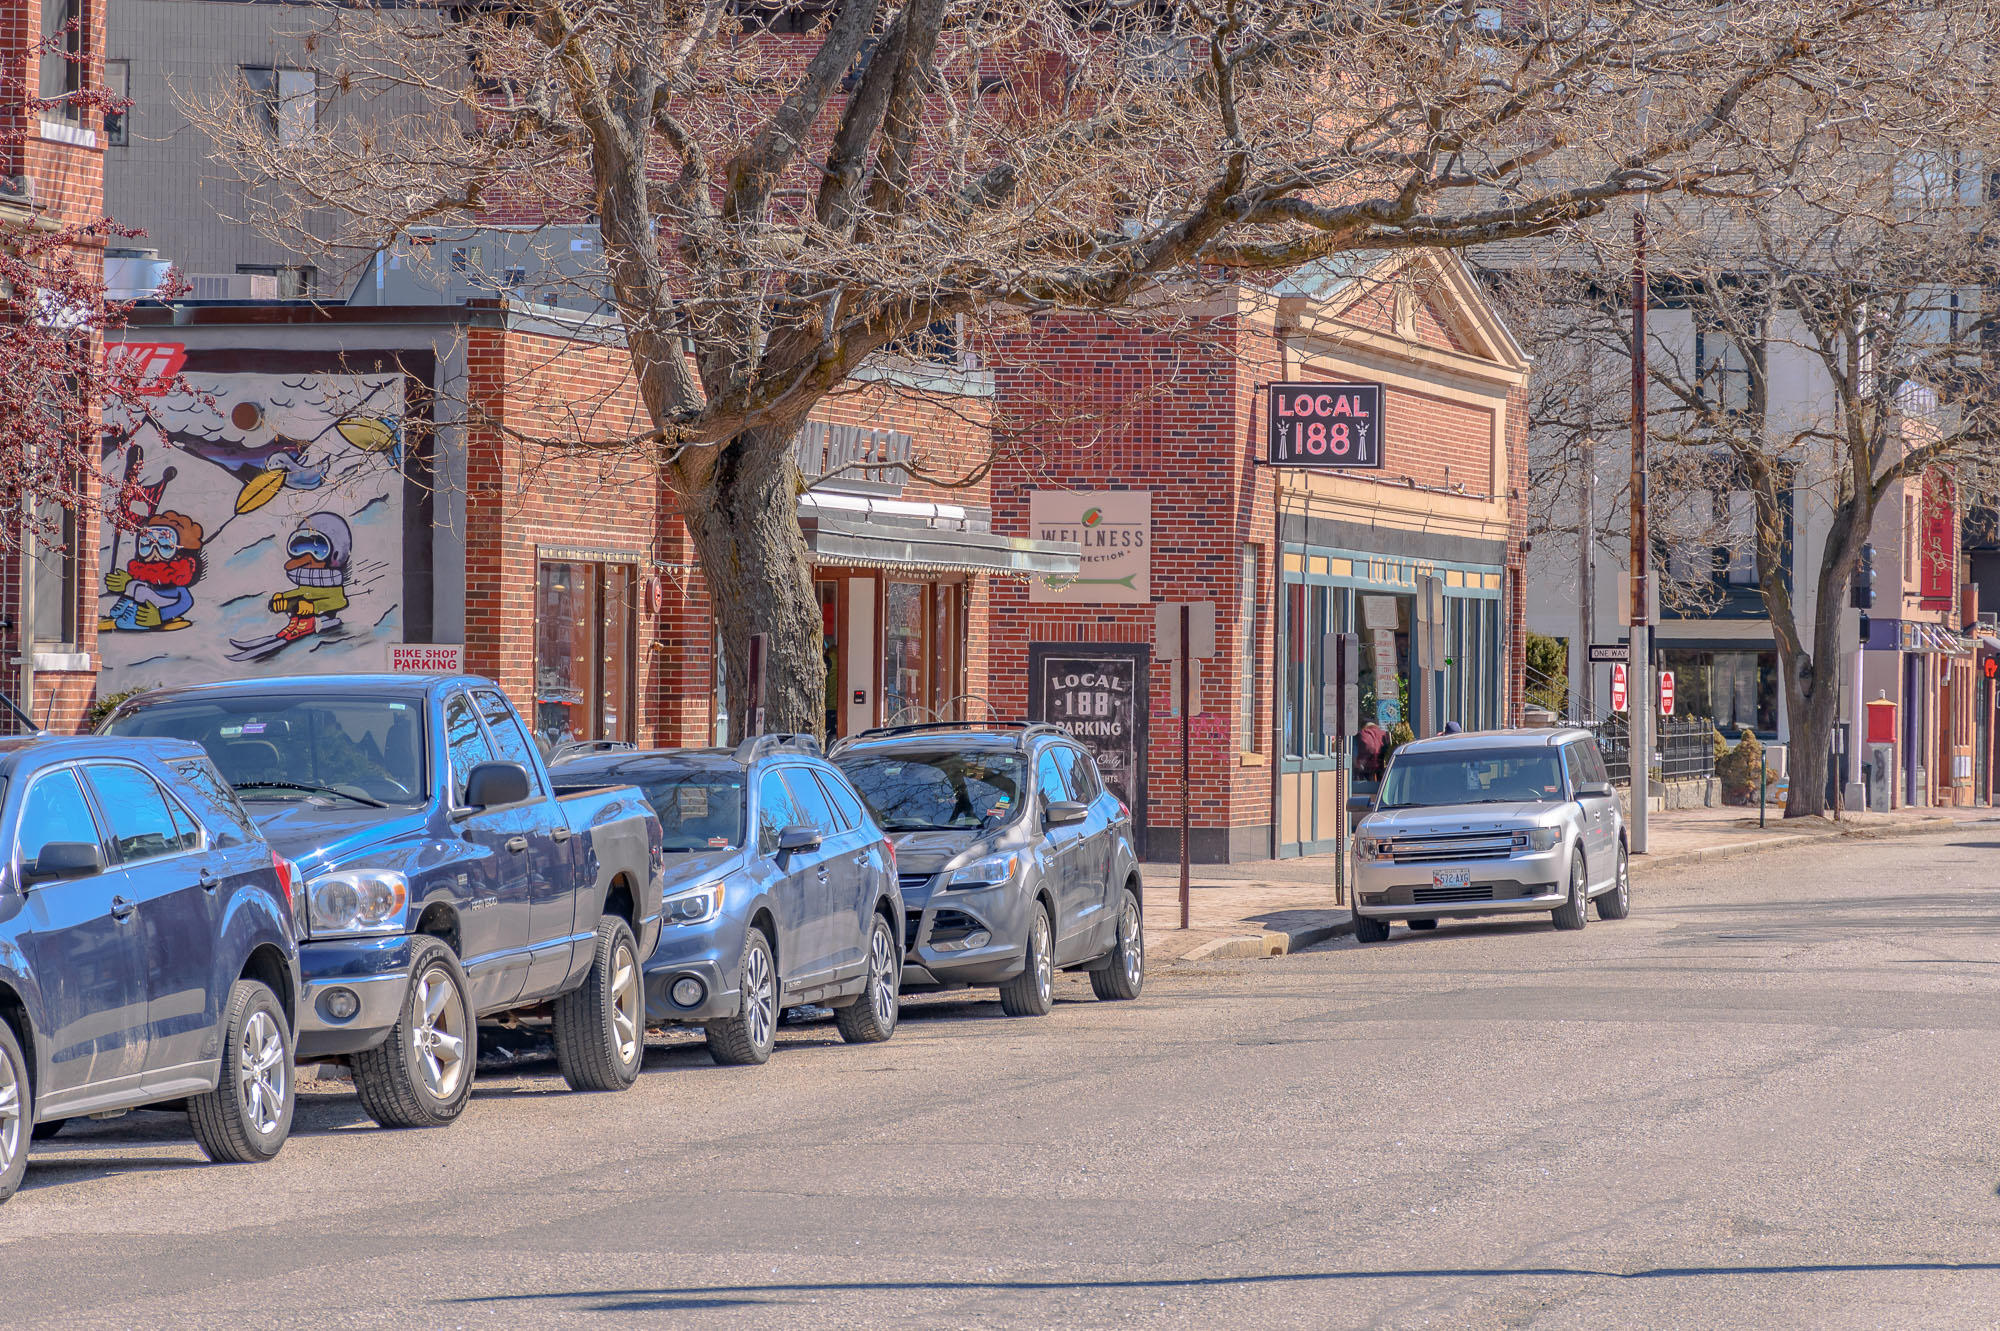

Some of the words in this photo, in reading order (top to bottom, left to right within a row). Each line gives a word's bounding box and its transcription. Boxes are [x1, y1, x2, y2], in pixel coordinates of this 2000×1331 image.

[1278, 393, 1370, 417] LOCAL
[1295, 421, 1350, 456] 188
[1041, 529, 1144, 548] WELLNESS
[1080, 550, 1125, 563] NECTION
[1368, 555, 1409, 588] LOCAL
[394, 649, 421, 658] BIKE
[425, 649, 457, 658] SHOP
[1593, 649, 1609, 658] ONE
[1611, 649, 1627, 658] WAY
[394, 659, 457, 670] PARKING
[1051, 673, 1125, 691] LOCAL
[1064, 691, 1109, 716] 188
[1055, 721, 1122, 736] PARKING
[1096, 754, 1122, 769] Only
